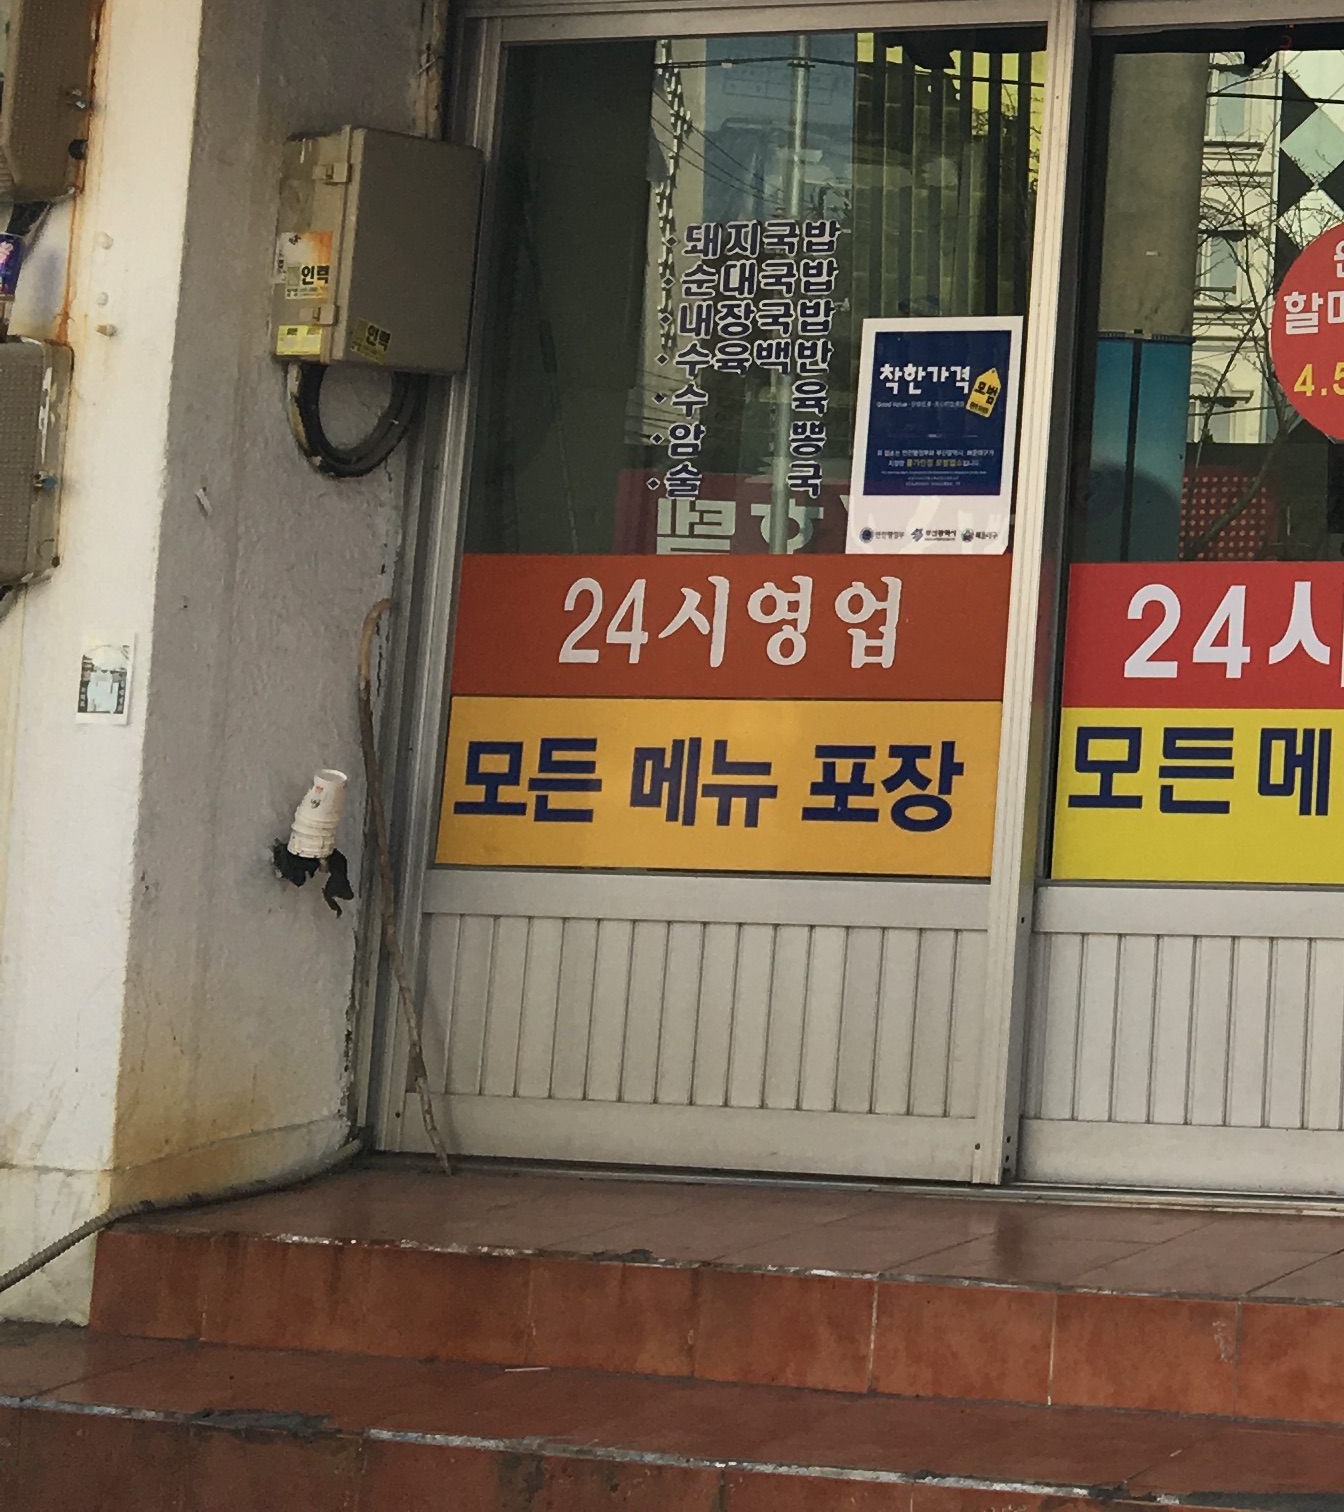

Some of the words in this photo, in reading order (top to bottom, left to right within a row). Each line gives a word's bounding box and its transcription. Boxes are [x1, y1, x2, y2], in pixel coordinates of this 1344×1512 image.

[681, 220, 841, 258] 돼지국밥
[301, 265, 330, 286] 인력
[680, 258, 838, 298] 순대국밥
[677, 297, 836, 339] 내장국밥
[673, 339, 834, 377] 수육백반
[879, 363, 970, 394] 착한가격
[974, 381, 998, 405] 모범
[558, 575, 903, 669] 24시영업
[453, 737, 602, 824] 모든
[629, 736, 778, 829] 메뉴
[801, 739, 965, 833] 포장
[1068, 725, 1235, 815] 모든
